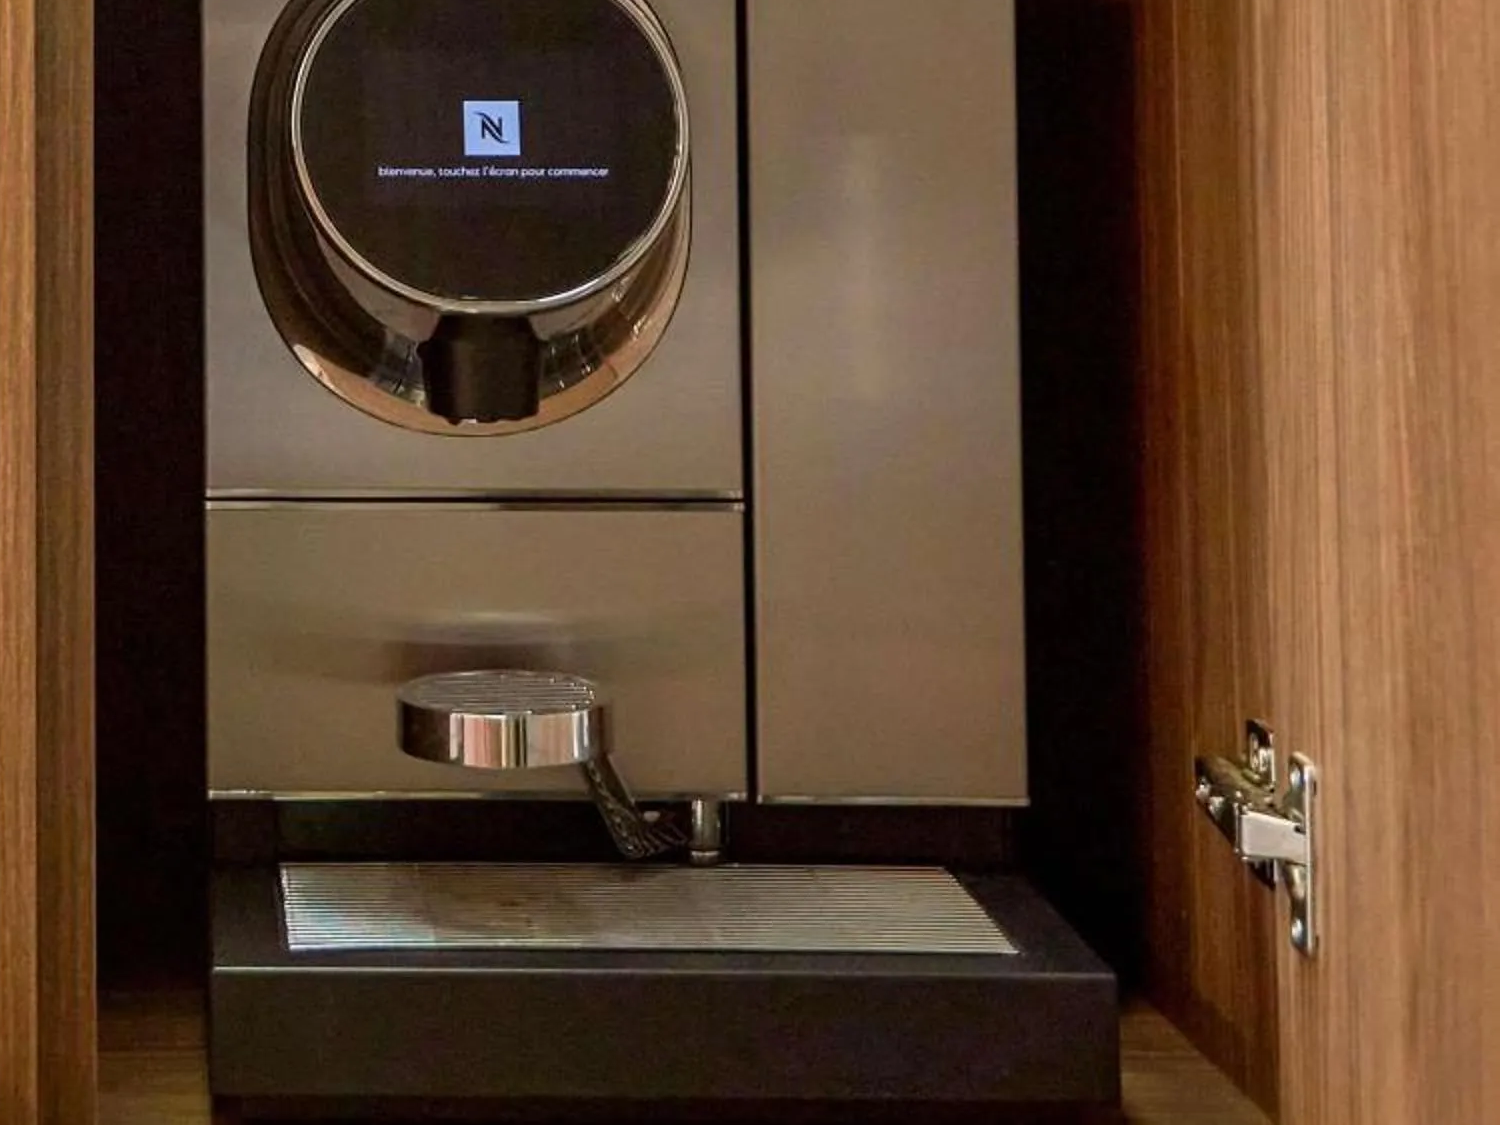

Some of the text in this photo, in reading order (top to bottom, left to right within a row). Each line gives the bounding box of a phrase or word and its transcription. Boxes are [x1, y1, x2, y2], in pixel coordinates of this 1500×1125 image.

[377, 164, 608, 177] bienvenue, touchez l'écran pour commencer
